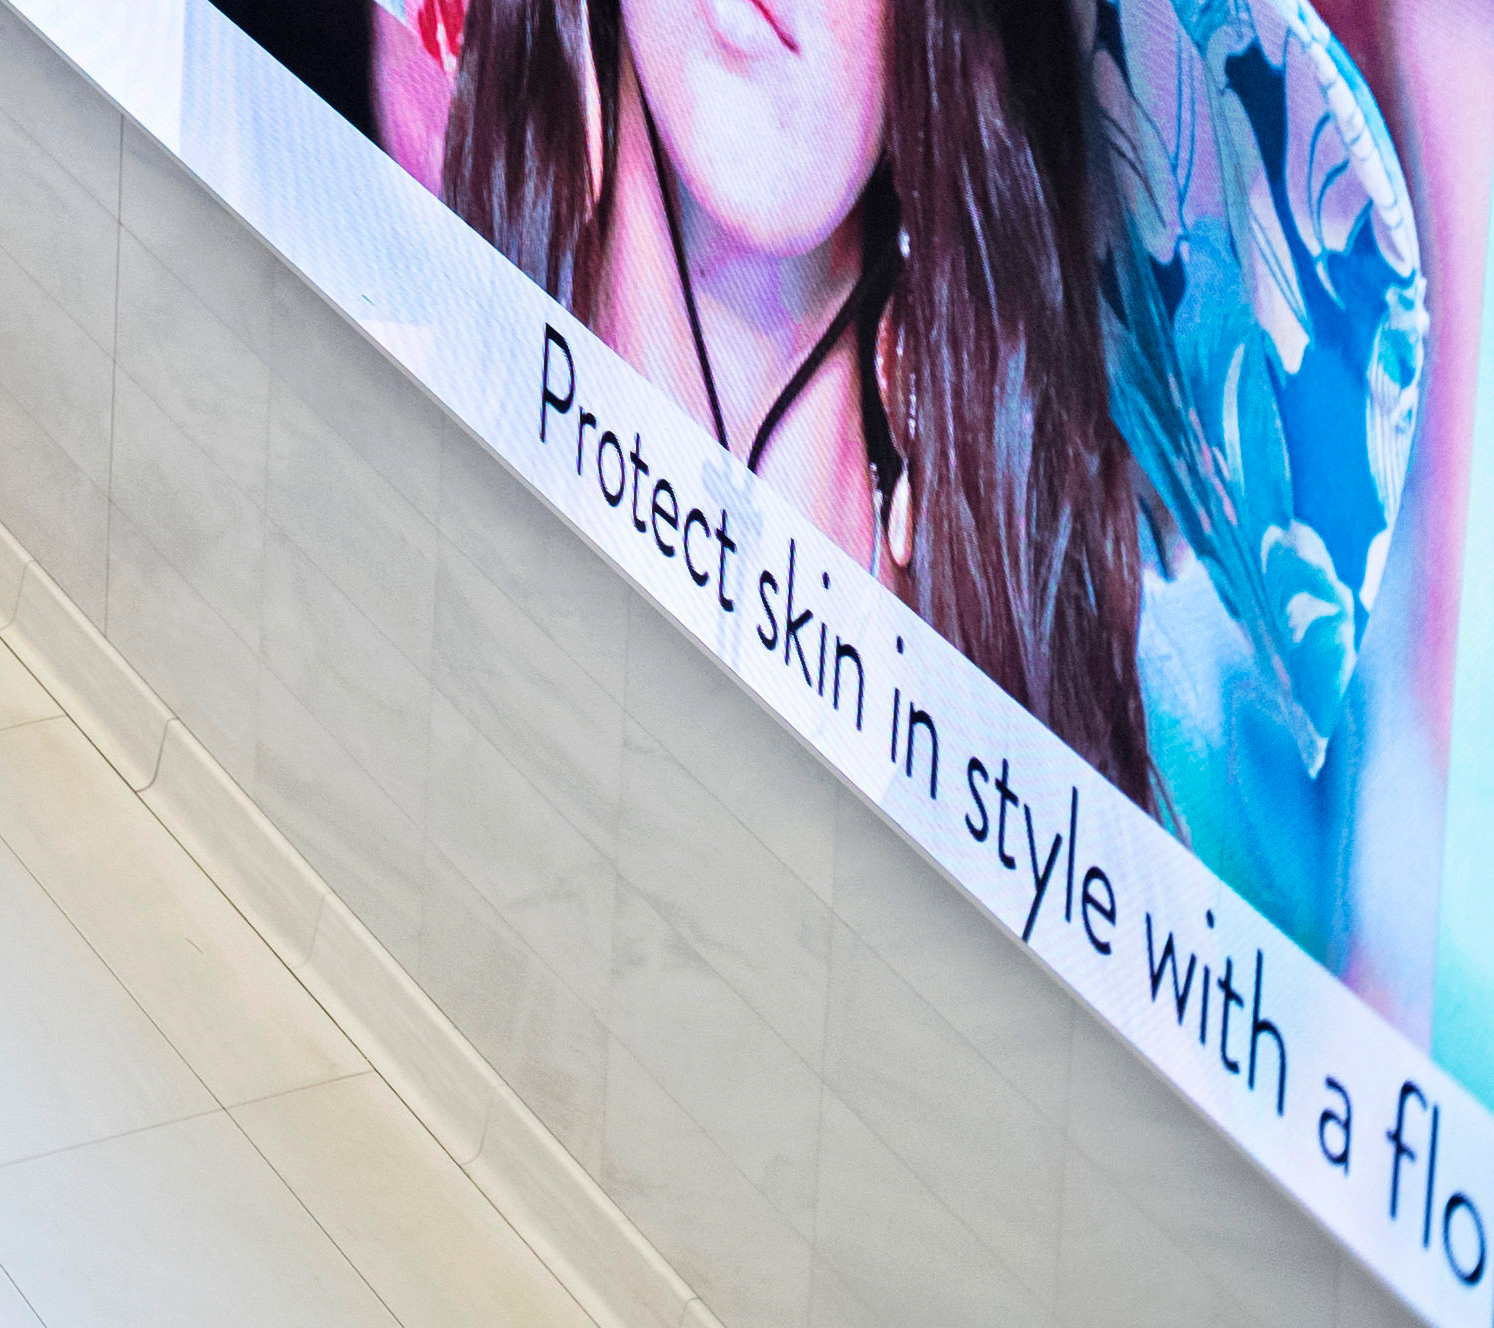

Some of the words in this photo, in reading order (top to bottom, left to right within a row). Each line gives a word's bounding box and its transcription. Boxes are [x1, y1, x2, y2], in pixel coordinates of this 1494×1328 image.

[536, 321, 738, 613] Protect
[756, 538, 867, 734] skin
[890, 634, 941, 802] in
[964, 756, 1119, 955] style
[1144, 908, 1288, 1117] with
[1316, 1073, 1352, 1178] a
[1386, 1077, 1490, 1288] flo
